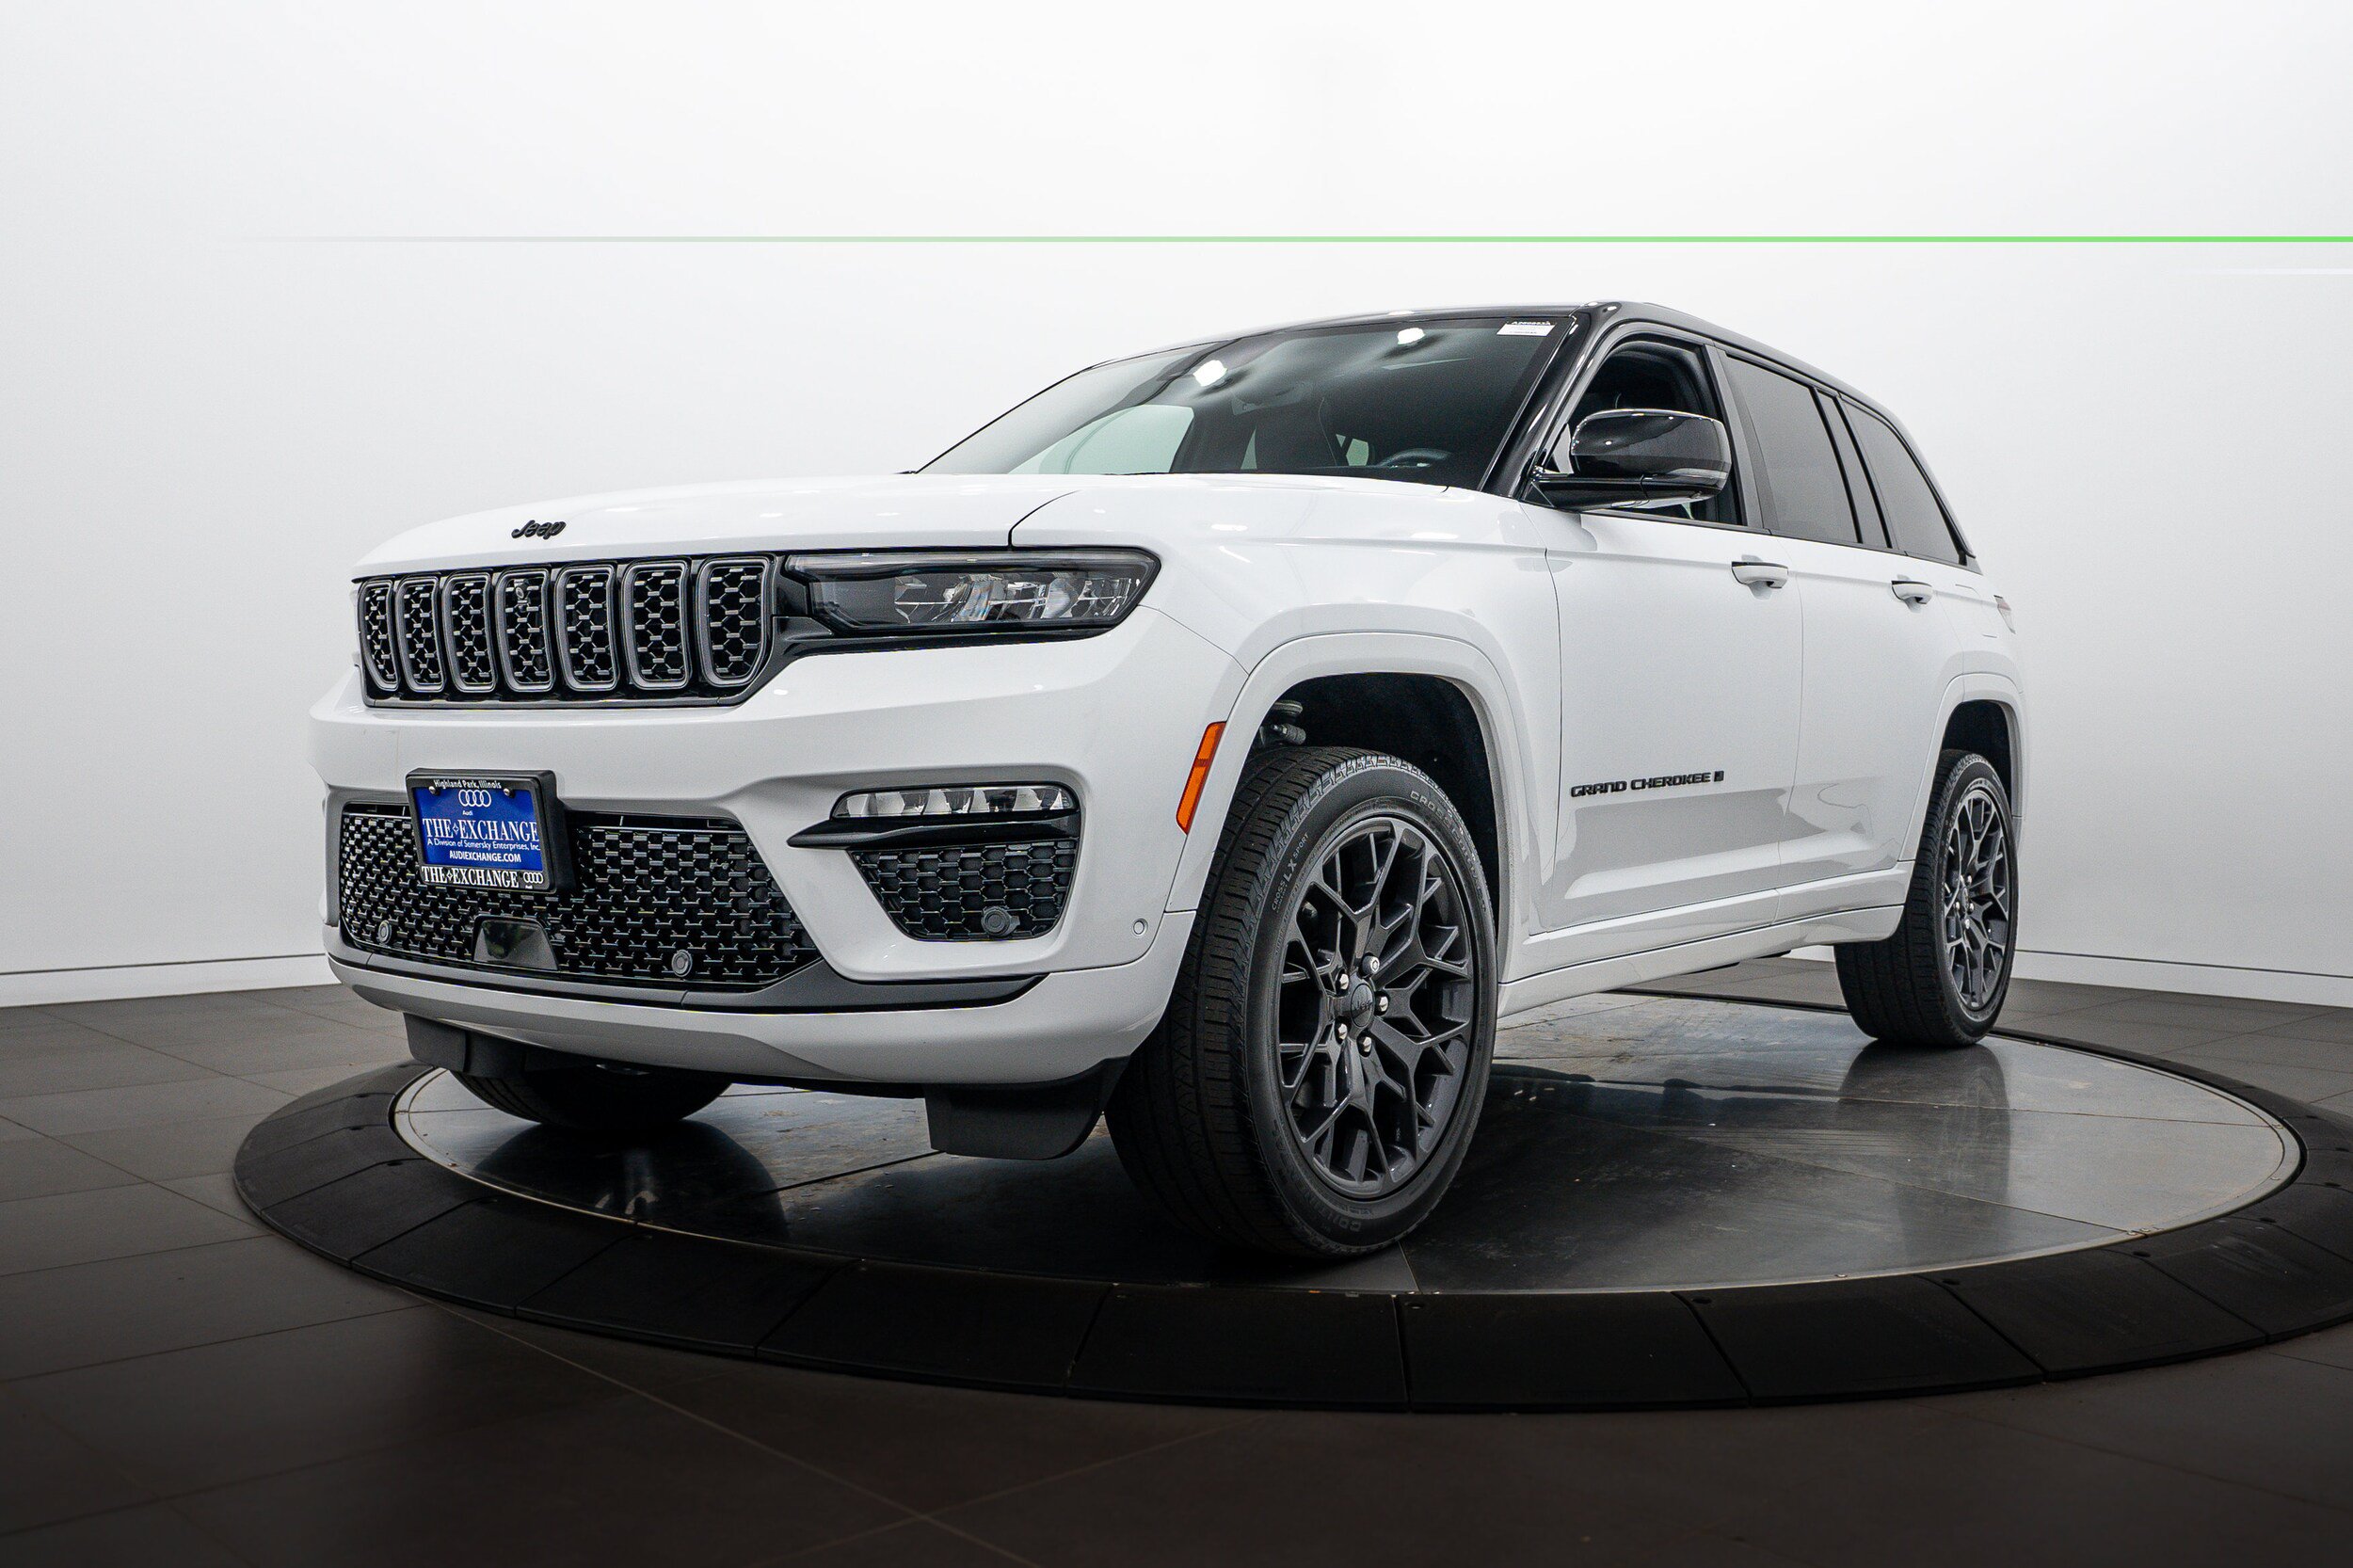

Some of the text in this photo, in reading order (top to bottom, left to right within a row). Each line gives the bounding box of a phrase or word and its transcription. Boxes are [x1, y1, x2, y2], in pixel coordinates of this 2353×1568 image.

[511, 520, 567, 540] Jeep
[433, 779, 502, 789] Highland Park, Illinois
[1570, 772, 1711, 797] GRAND CHEROKEE
[422, 818, 540, 842] THE EXCHANGE
[427, 838, 433, 846] A
[530, 842, 541, 851] Inc.
[449, 850, 521, 863] AUDIEXCHANGE.COM
[421, 866, 520, 888] THE EXCHANGE
